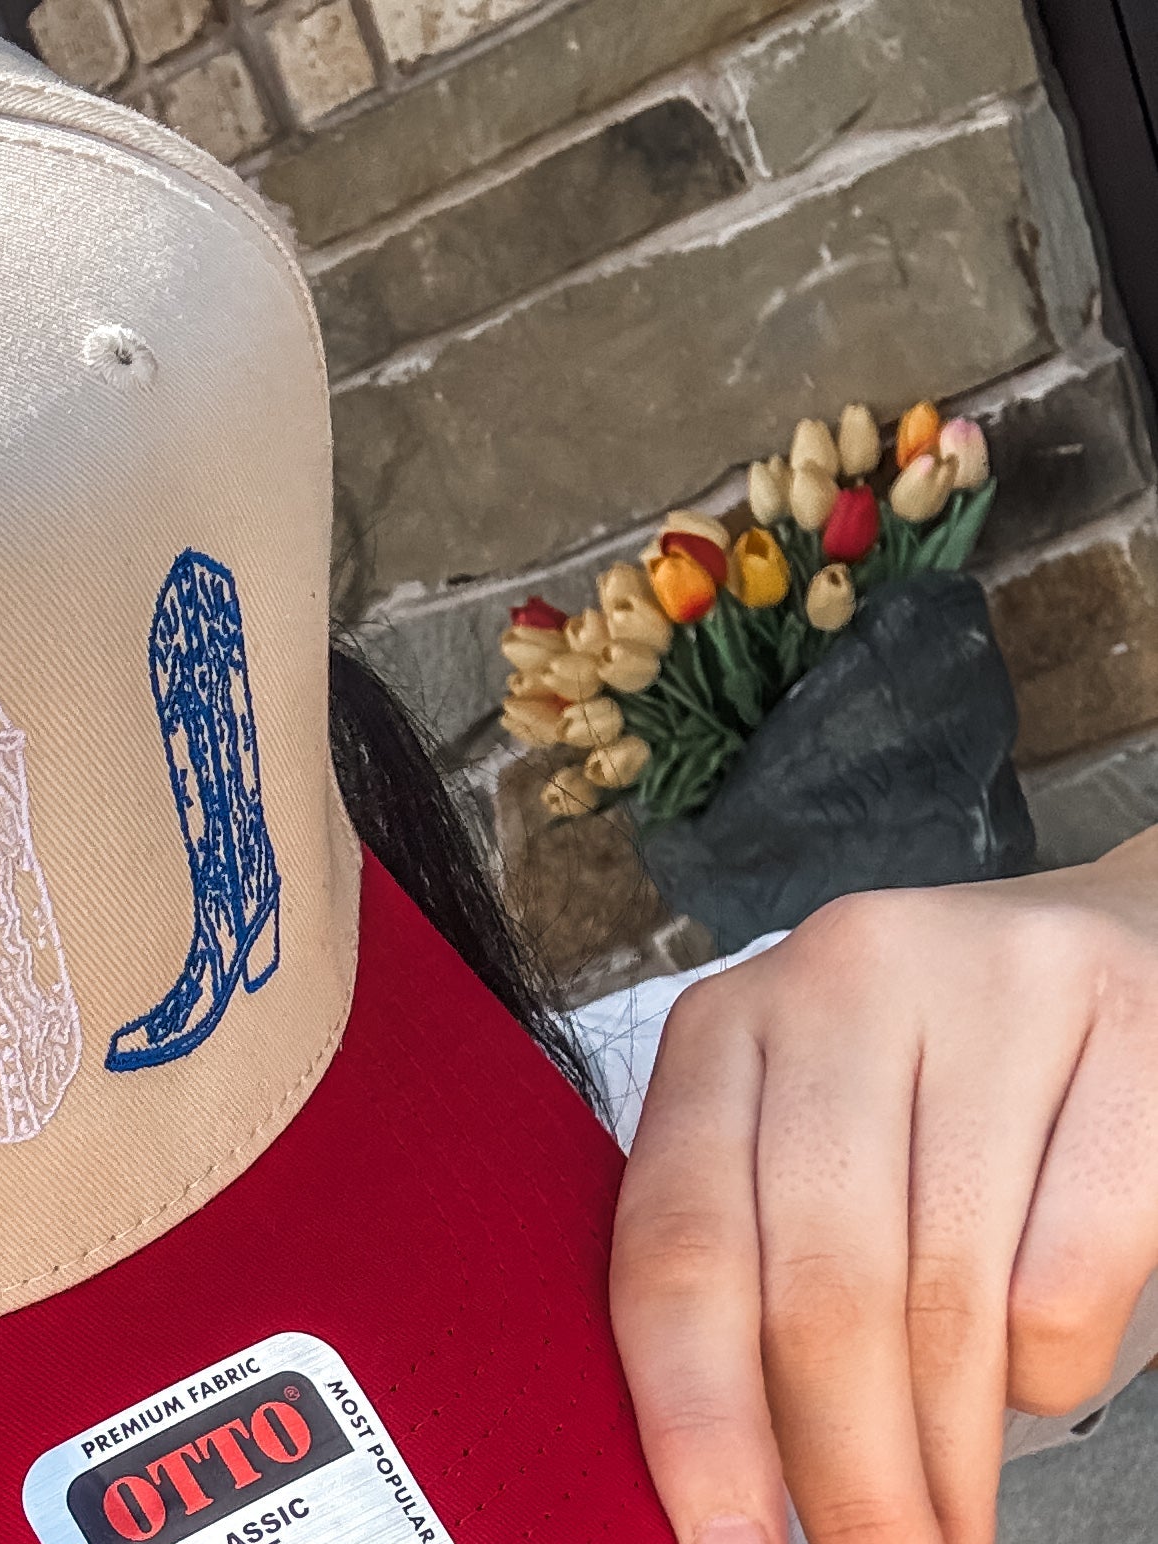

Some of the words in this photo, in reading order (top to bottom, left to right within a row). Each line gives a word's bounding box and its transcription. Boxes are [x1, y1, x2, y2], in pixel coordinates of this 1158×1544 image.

[80, 1396, 185, 1459] PREMIUM
[188, 1357, 262, 1403] FABRIC
[103, 1400, 312, 1542] OTTO
[329, 1380, 374, 1438] MOST
[369, 1444, 434, 1544] POPULAR
